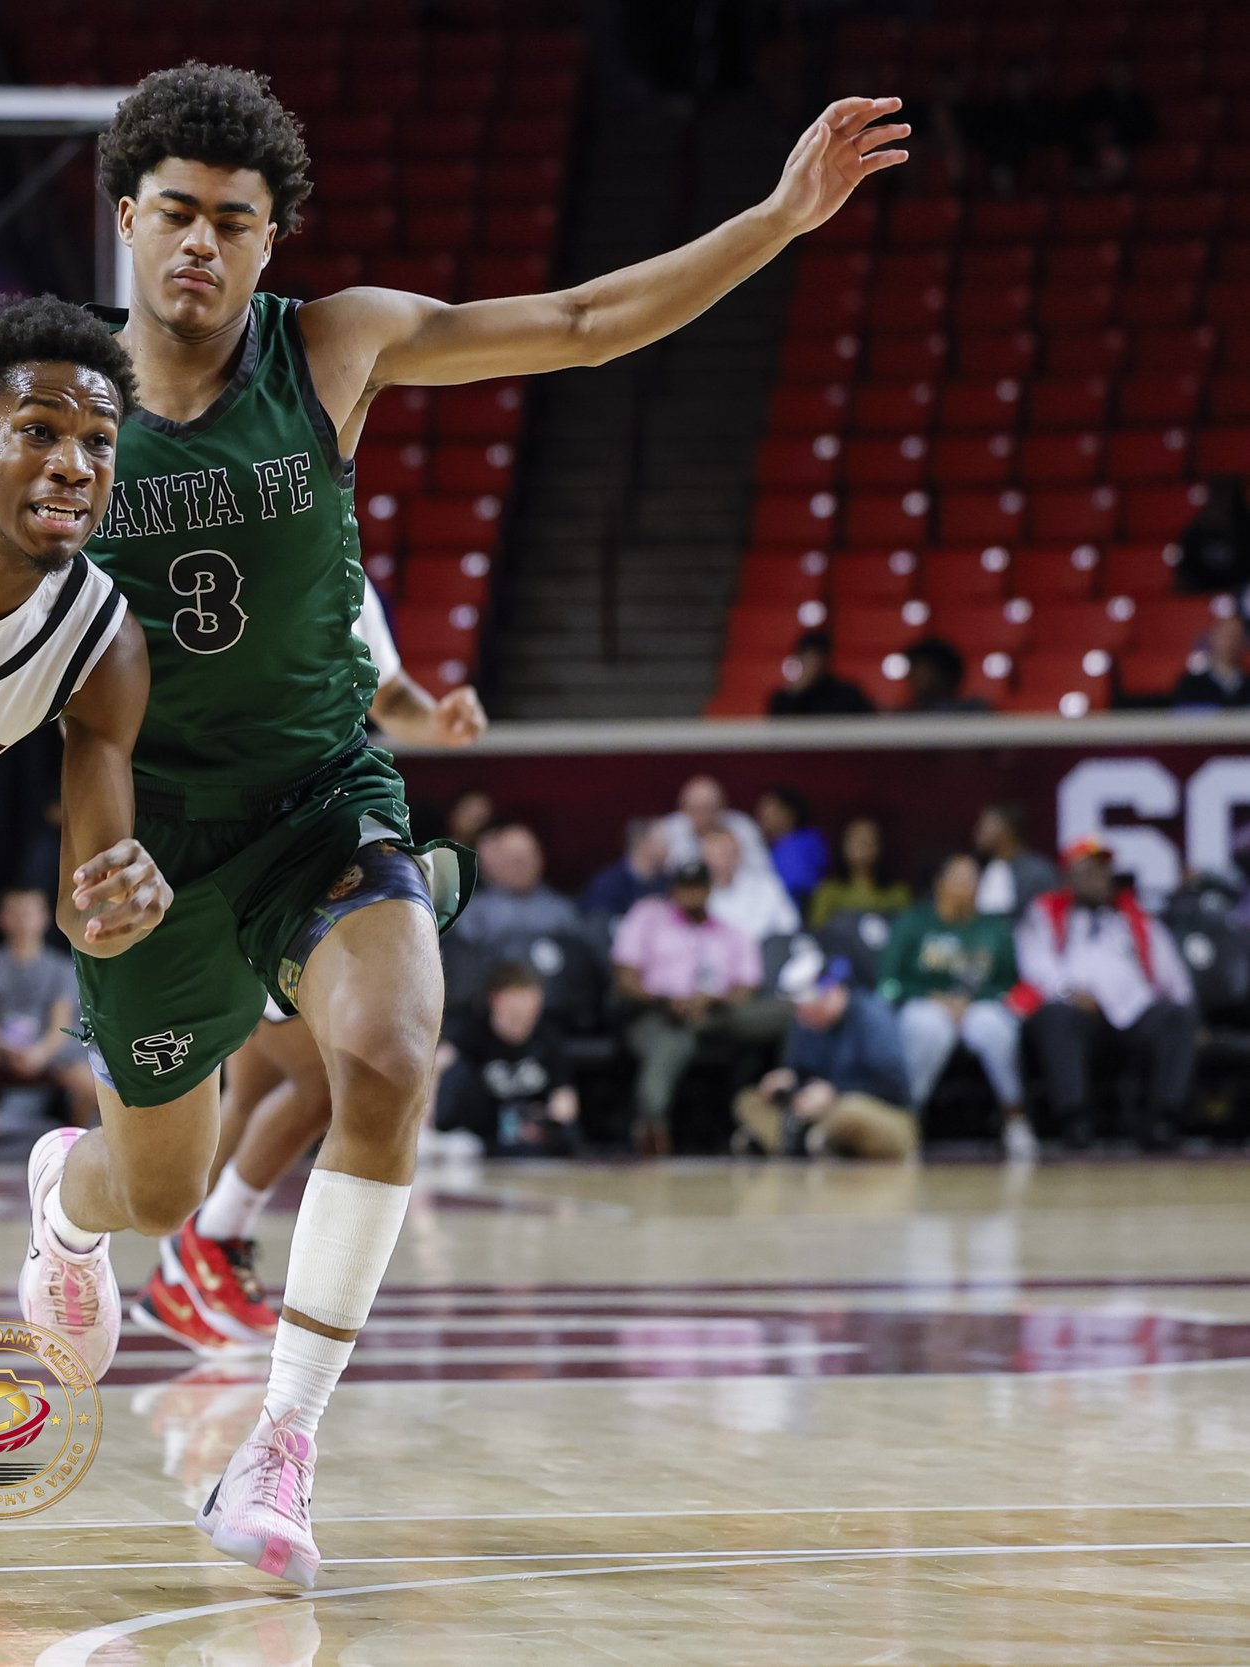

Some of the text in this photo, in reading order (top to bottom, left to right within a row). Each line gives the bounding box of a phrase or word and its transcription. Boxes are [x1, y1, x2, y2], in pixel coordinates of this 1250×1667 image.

[92, 452, 313, 540] ANTA FE
[168, 549, 249, 655] 3
